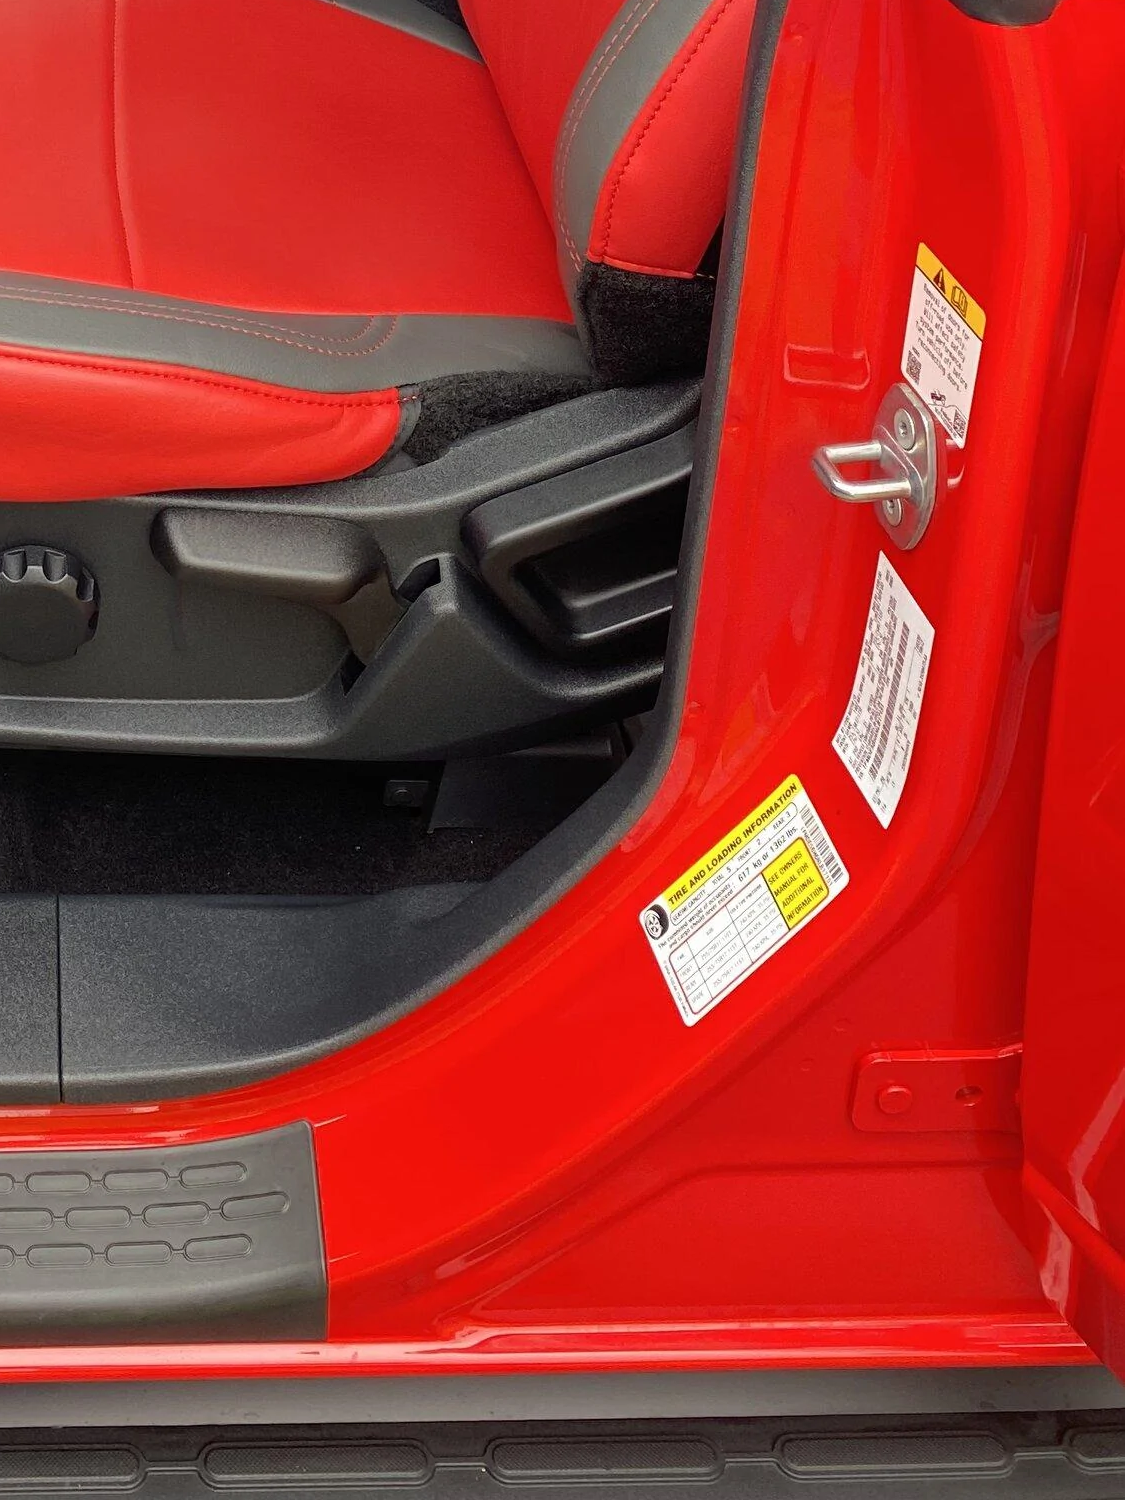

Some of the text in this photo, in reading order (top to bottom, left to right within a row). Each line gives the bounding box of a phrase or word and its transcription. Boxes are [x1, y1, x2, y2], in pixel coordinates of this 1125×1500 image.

[784, 810, 791, 819] 3
[667, 782, 798, 906] TIRE AND LOADING INFORMATION
[737, 866, 751, 883] 617
[751, 856, 762, 870] kg
[760, 850, 769, 862] or
[768, 833, 787, 854] 1362
[755, 837, 762, 846] 2
[767, 850, 803, 886] SEE OWNERS
[773, 861, 809, 898] MANUAL FOR
[780, 874, 815, 909] ADDITIONAL
[785, 883, 824, 923] INFORMATION
